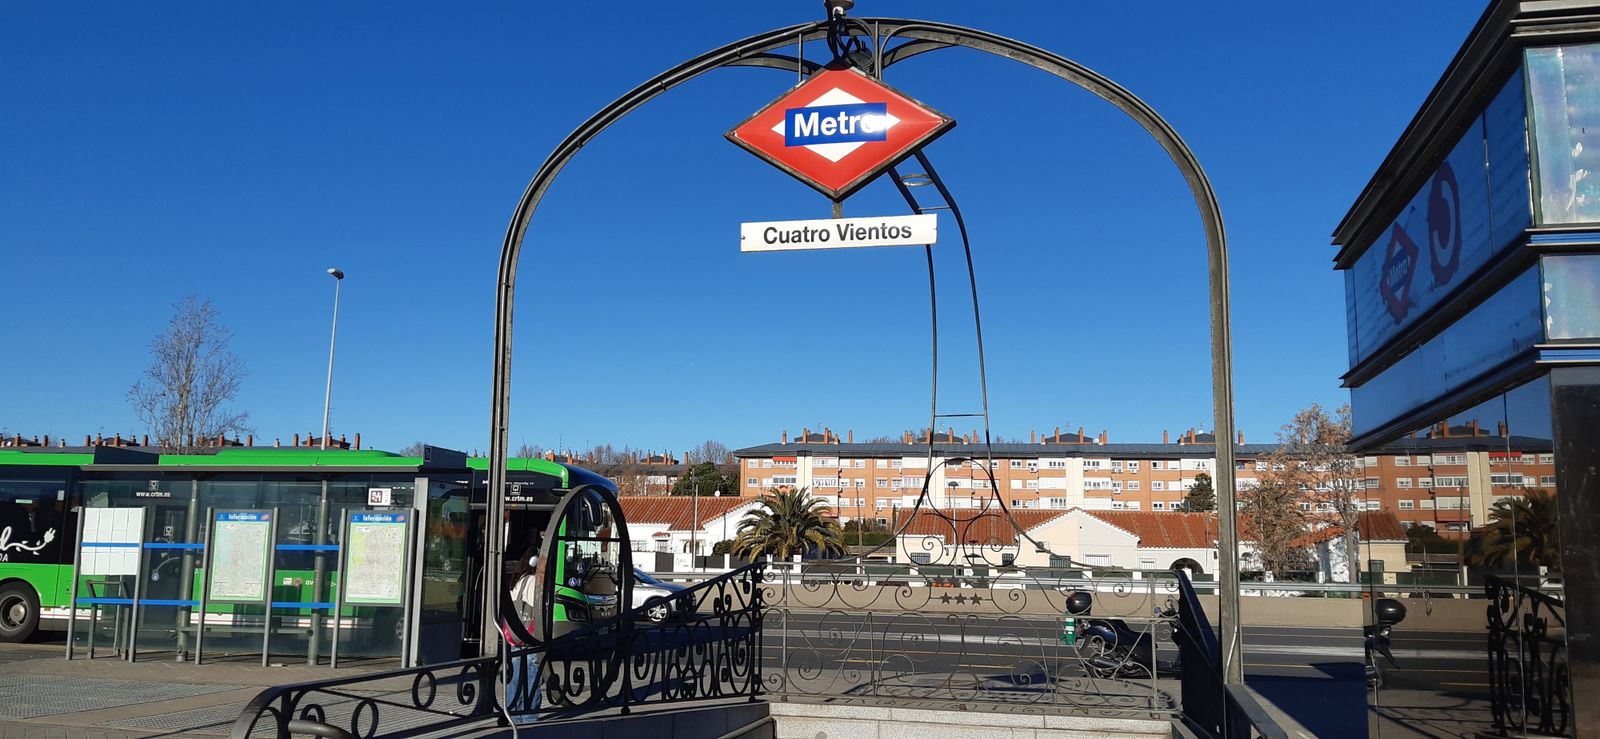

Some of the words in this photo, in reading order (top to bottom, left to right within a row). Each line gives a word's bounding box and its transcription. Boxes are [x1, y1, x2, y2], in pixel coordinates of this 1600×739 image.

[794, 111, 880, 138] Metro
[763, 226, 831, 244] Cuatro
[836, 222, 913, 241] Vientos
[1389, 257, 1408, 288] Metro
